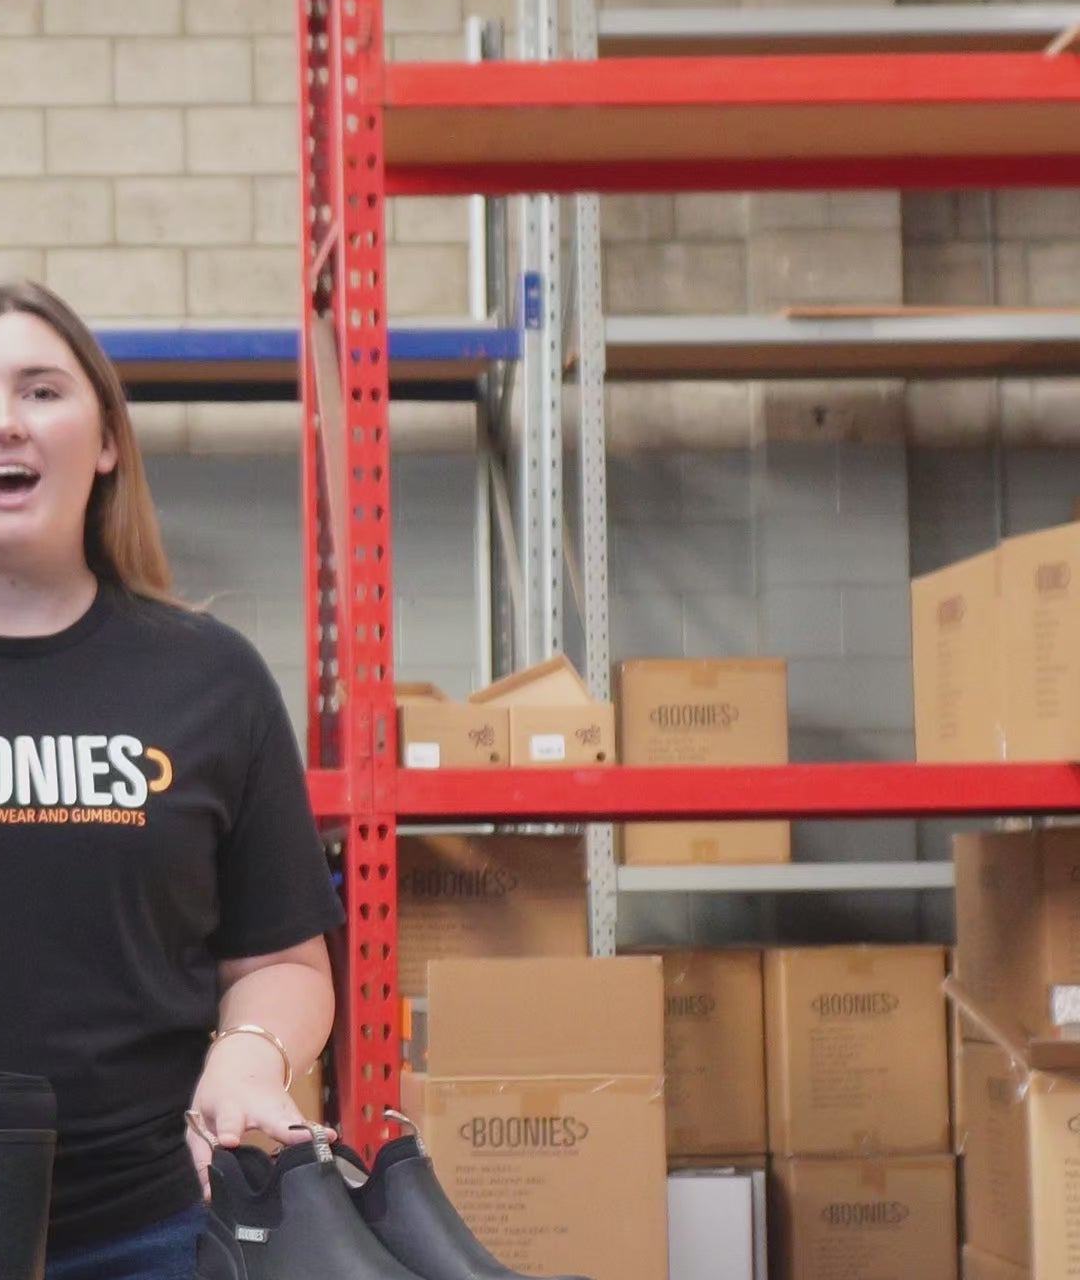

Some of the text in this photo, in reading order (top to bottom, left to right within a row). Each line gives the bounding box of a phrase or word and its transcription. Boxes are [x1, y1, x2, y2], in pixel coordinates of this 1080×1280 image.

[38, 808, 69, 824] AND
[72, 808, 146, 827] GUMBOOTS
[471, 1116, 577, 1148] BOONIES
